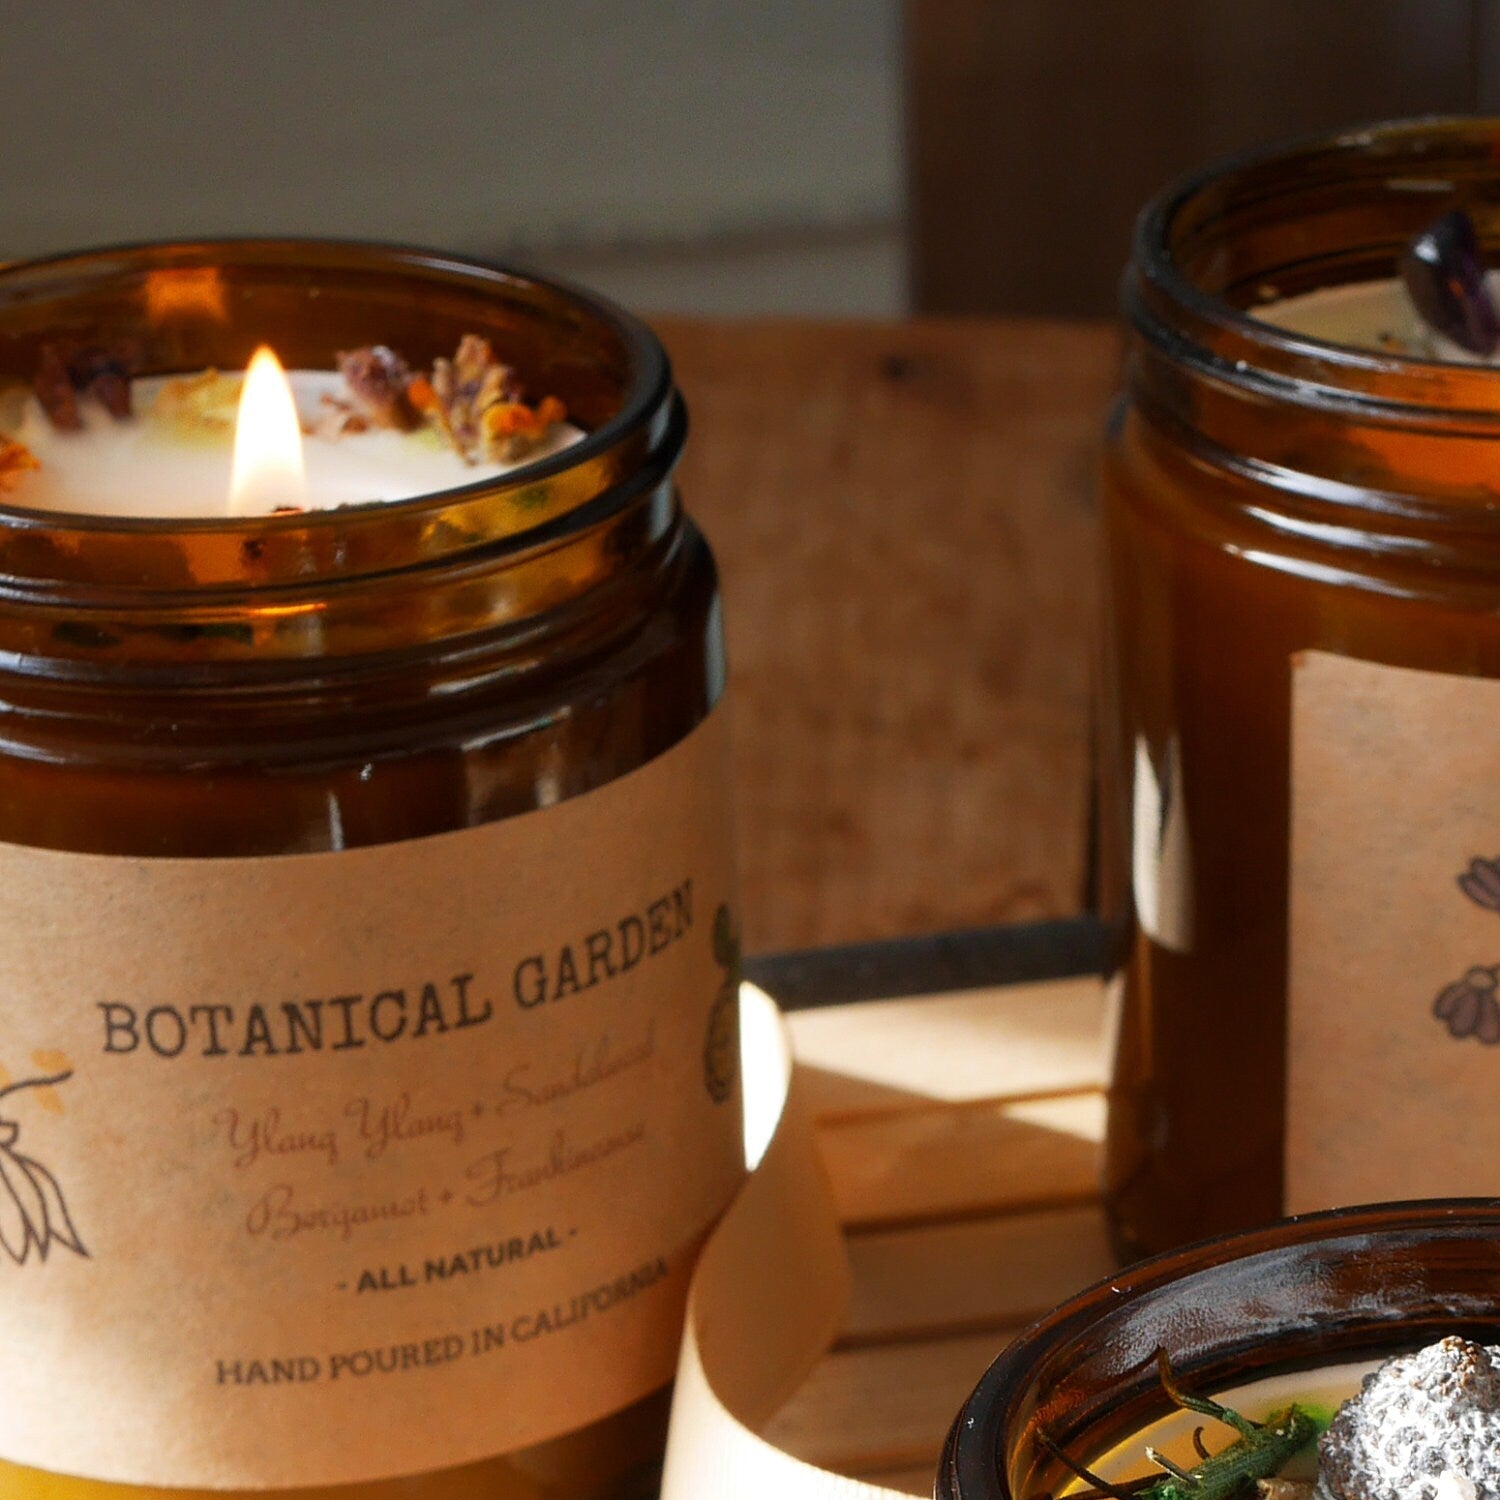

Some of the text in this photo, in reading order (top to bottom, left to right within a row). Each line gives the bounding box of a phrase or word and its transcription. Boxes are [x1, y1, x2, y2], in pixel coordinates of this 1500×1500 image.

[97, 878, 694, 1058] BOTANICAL GARDEN
[212, 1106, 338, 1168] Ylang
[345, 1092, 464, 1160] Ylang
[356, 1269, 416, 1294] ALL
[425, 1226, 560, 1283] NATURAL
[216, 1257, 669, 1386] HAND POURED IN CALIFORNIA
